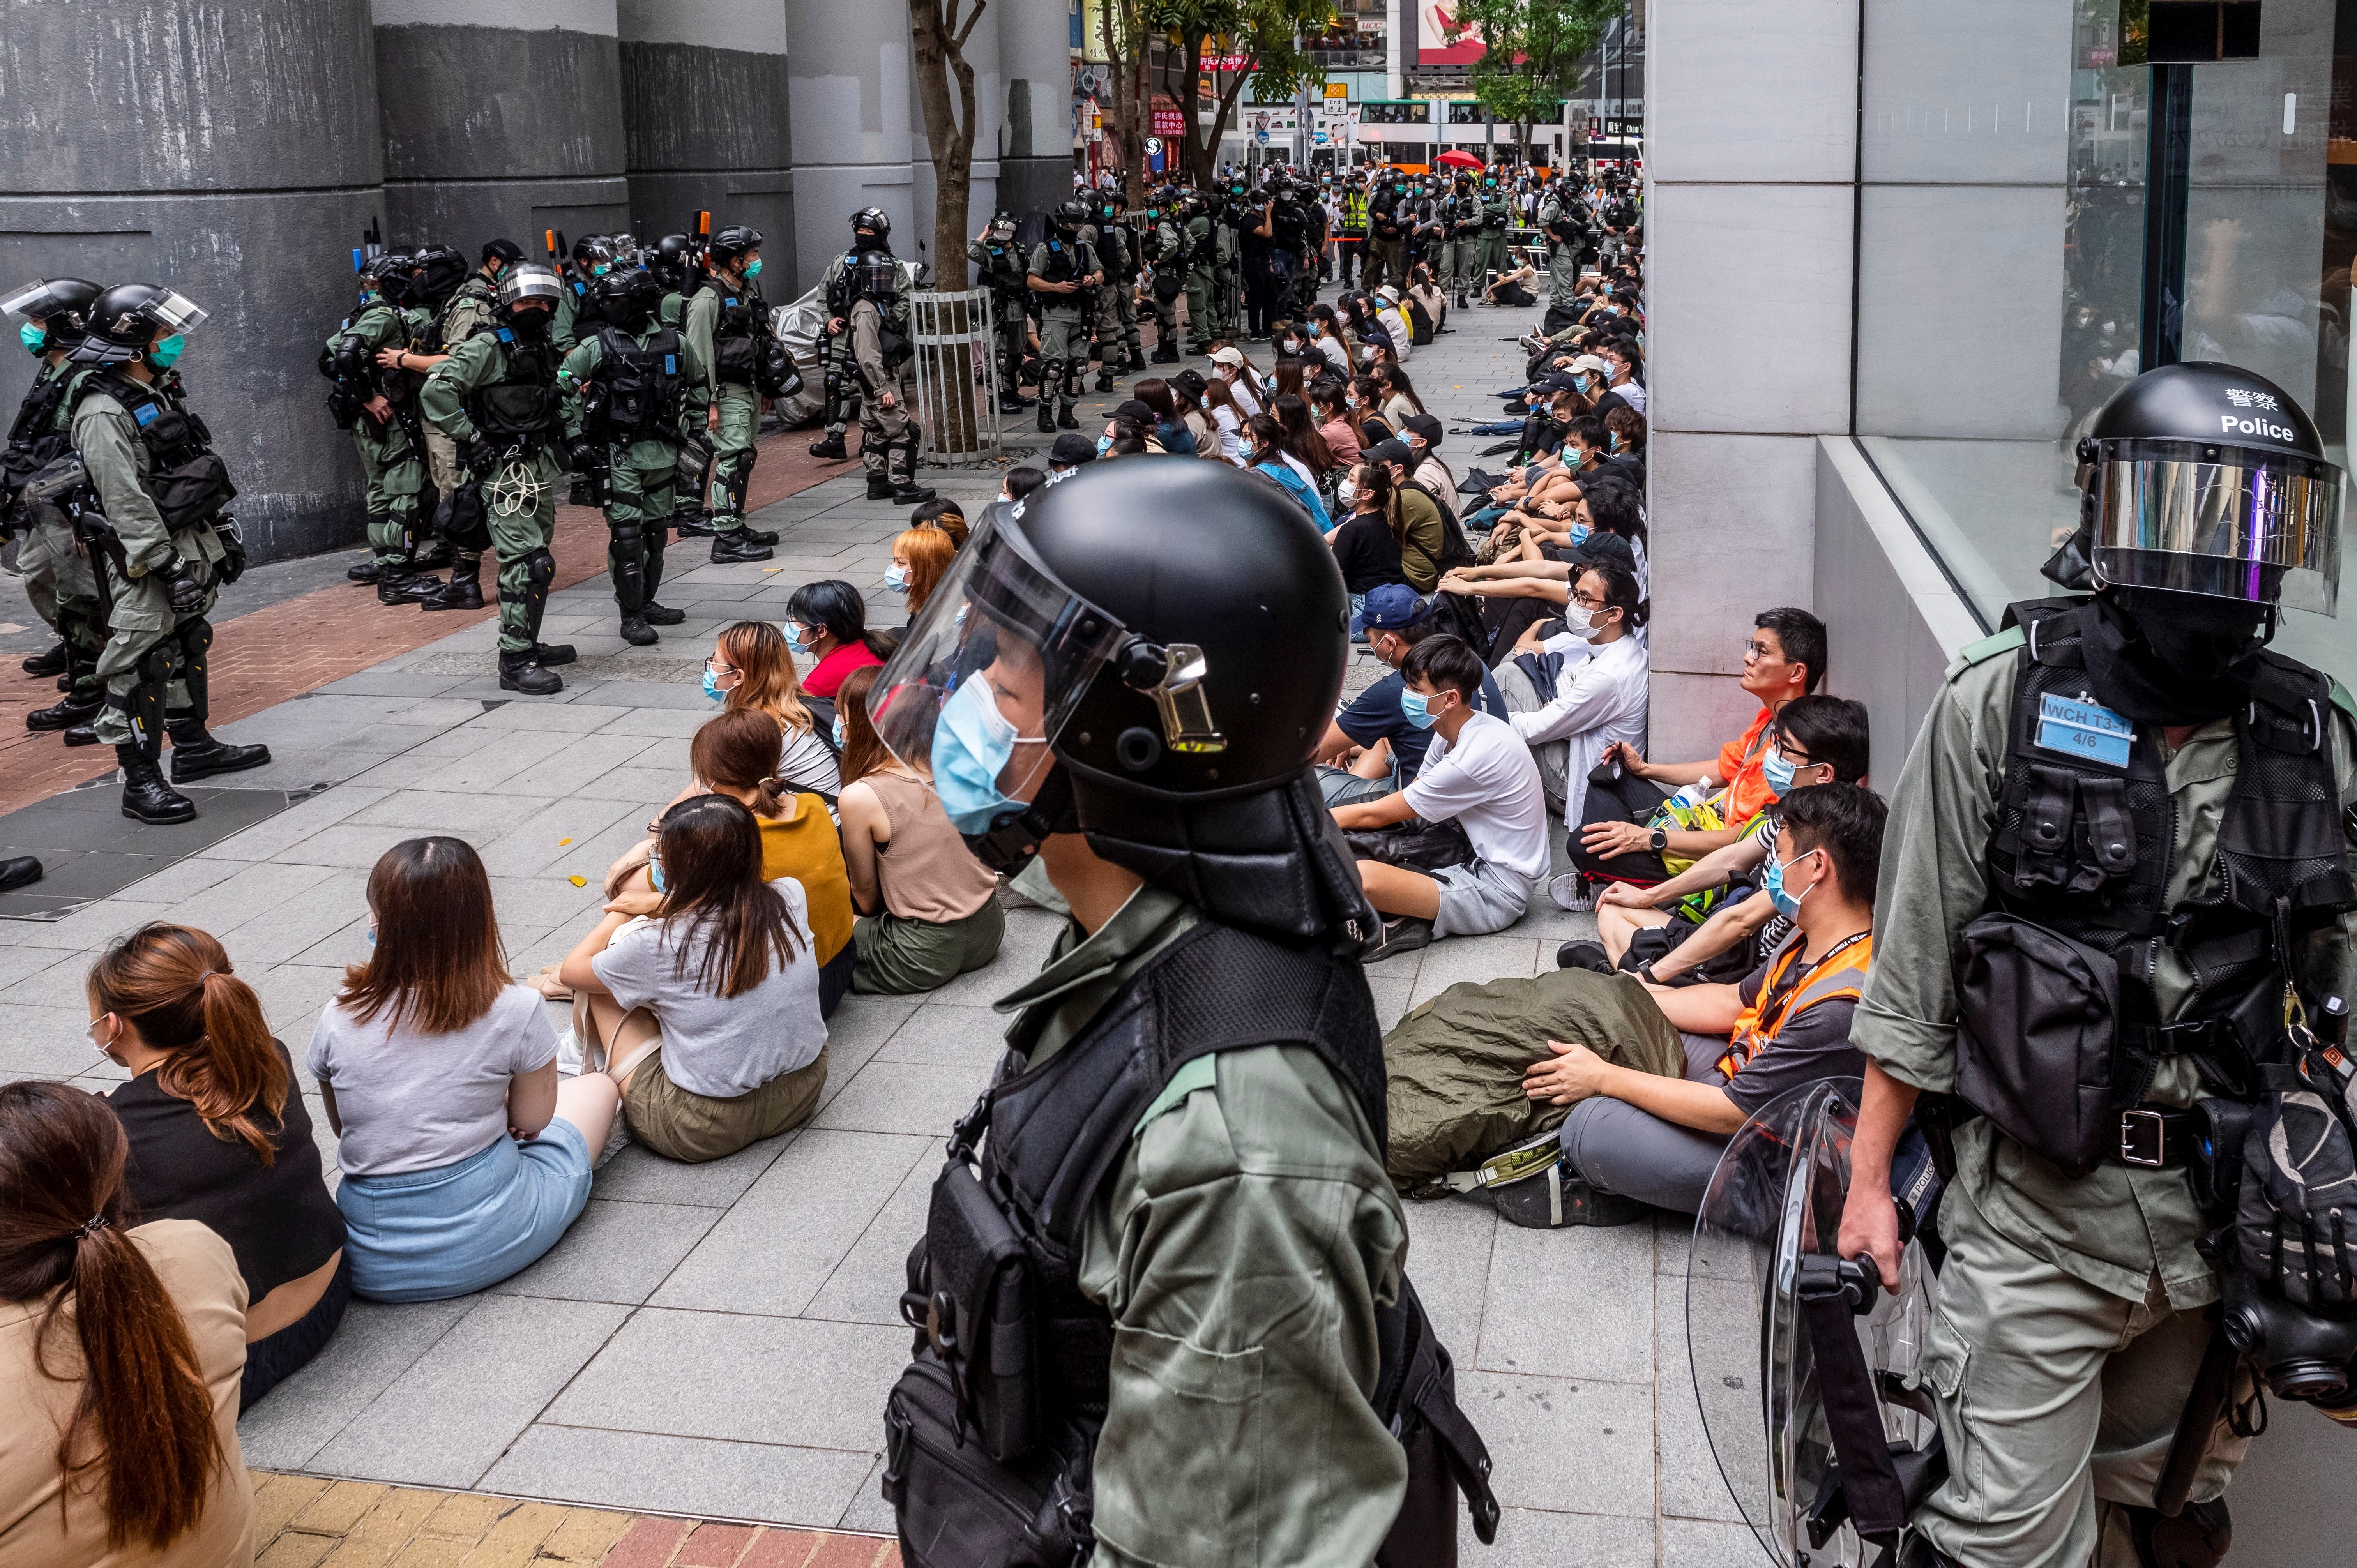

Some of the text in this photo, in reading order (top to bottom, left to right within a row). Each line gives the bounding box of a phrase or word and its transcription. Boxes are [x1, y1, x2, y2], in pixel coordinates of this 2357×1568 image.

[1154, 112, 1182, 120] 許氏找換
[1154, 120, 1182, 129] 匯款中心
[2224, 388, 2278, 412] 警察
[2221, 415, 2293, 441] Police
[2048, 704, 2087, 724] WCH
[2072, 733, 2096, 748] 4/6
[1834, 941, 1848, 952] CIRCLE
